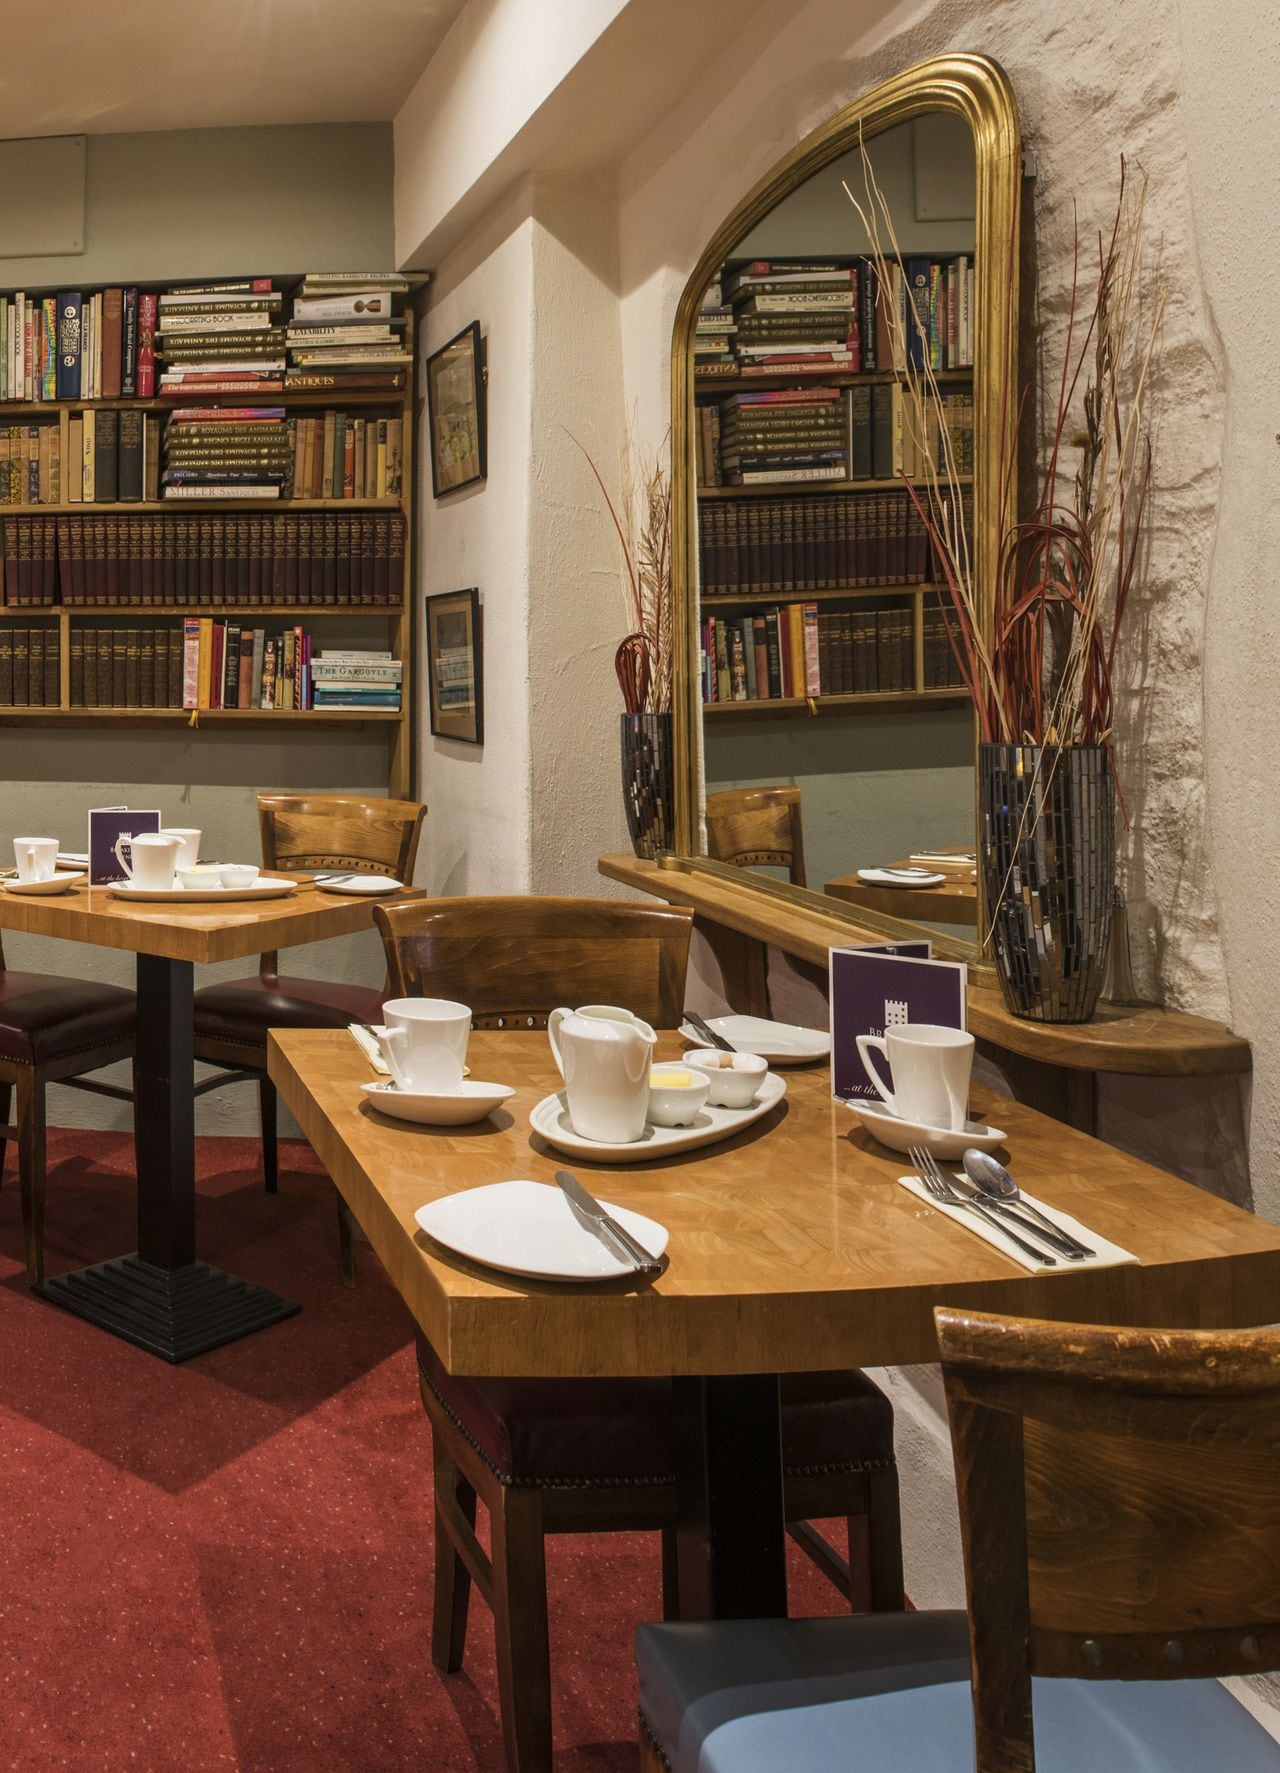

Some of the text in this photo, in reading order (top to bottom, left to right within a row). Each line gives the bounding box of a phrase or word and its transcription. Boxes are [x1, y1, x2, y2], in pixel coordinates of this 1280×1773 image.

[288, 376, 335, 386] ANTIQUES
[180, 382, 218, 390] International
[170, 487, 225, 496] MILLER'S
[319, 667, 388, 676] THE GARGOYLE
